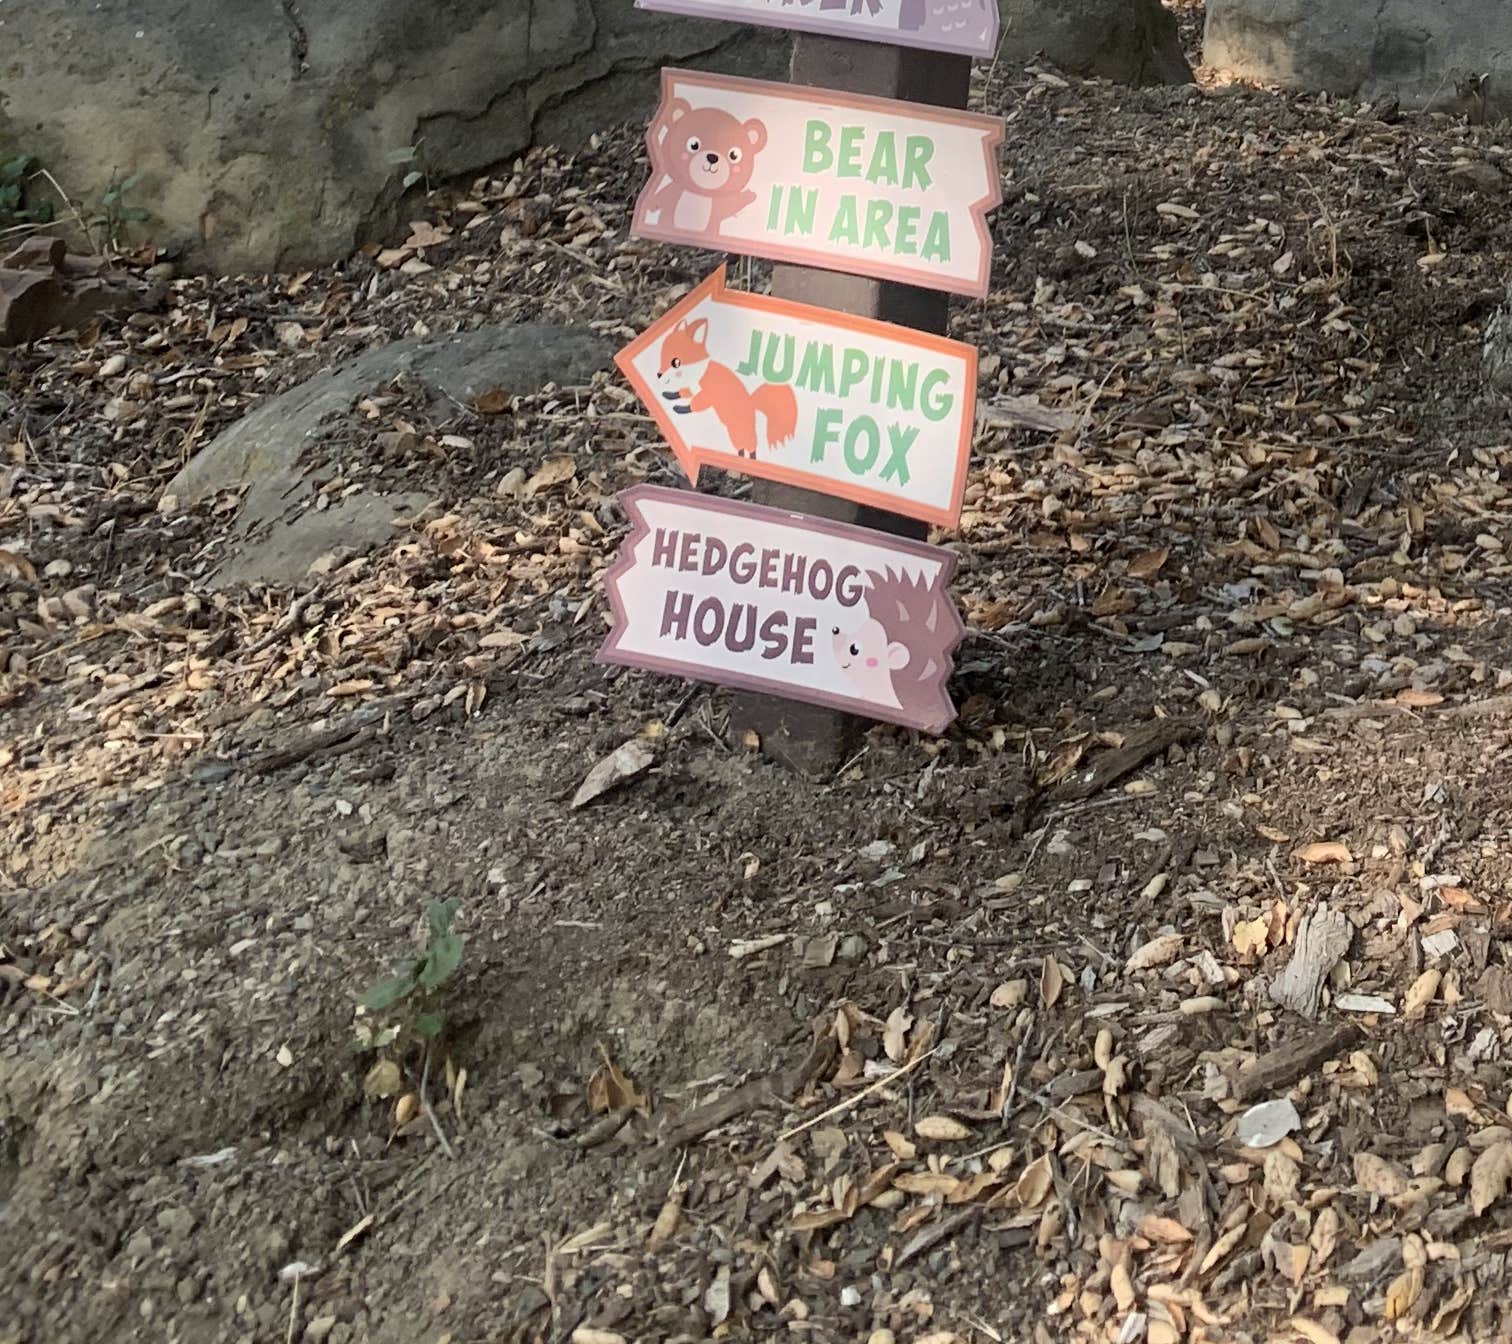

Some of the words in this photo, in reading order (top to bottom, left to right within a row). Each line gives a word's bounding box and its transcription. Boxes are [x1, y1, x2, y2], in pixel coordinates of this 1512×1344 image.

[801, 118, 936, 190] BEAR
[766, 183, 816, 237] IN
[827, 194, 952, 263] AREA
[735, 328, 955, 423] JUMPING
[809, 406, 921, 487] FOX
[651, 527, 867, 606] HEDGEHOG
[659, 590, 818, 664] HOUSE
